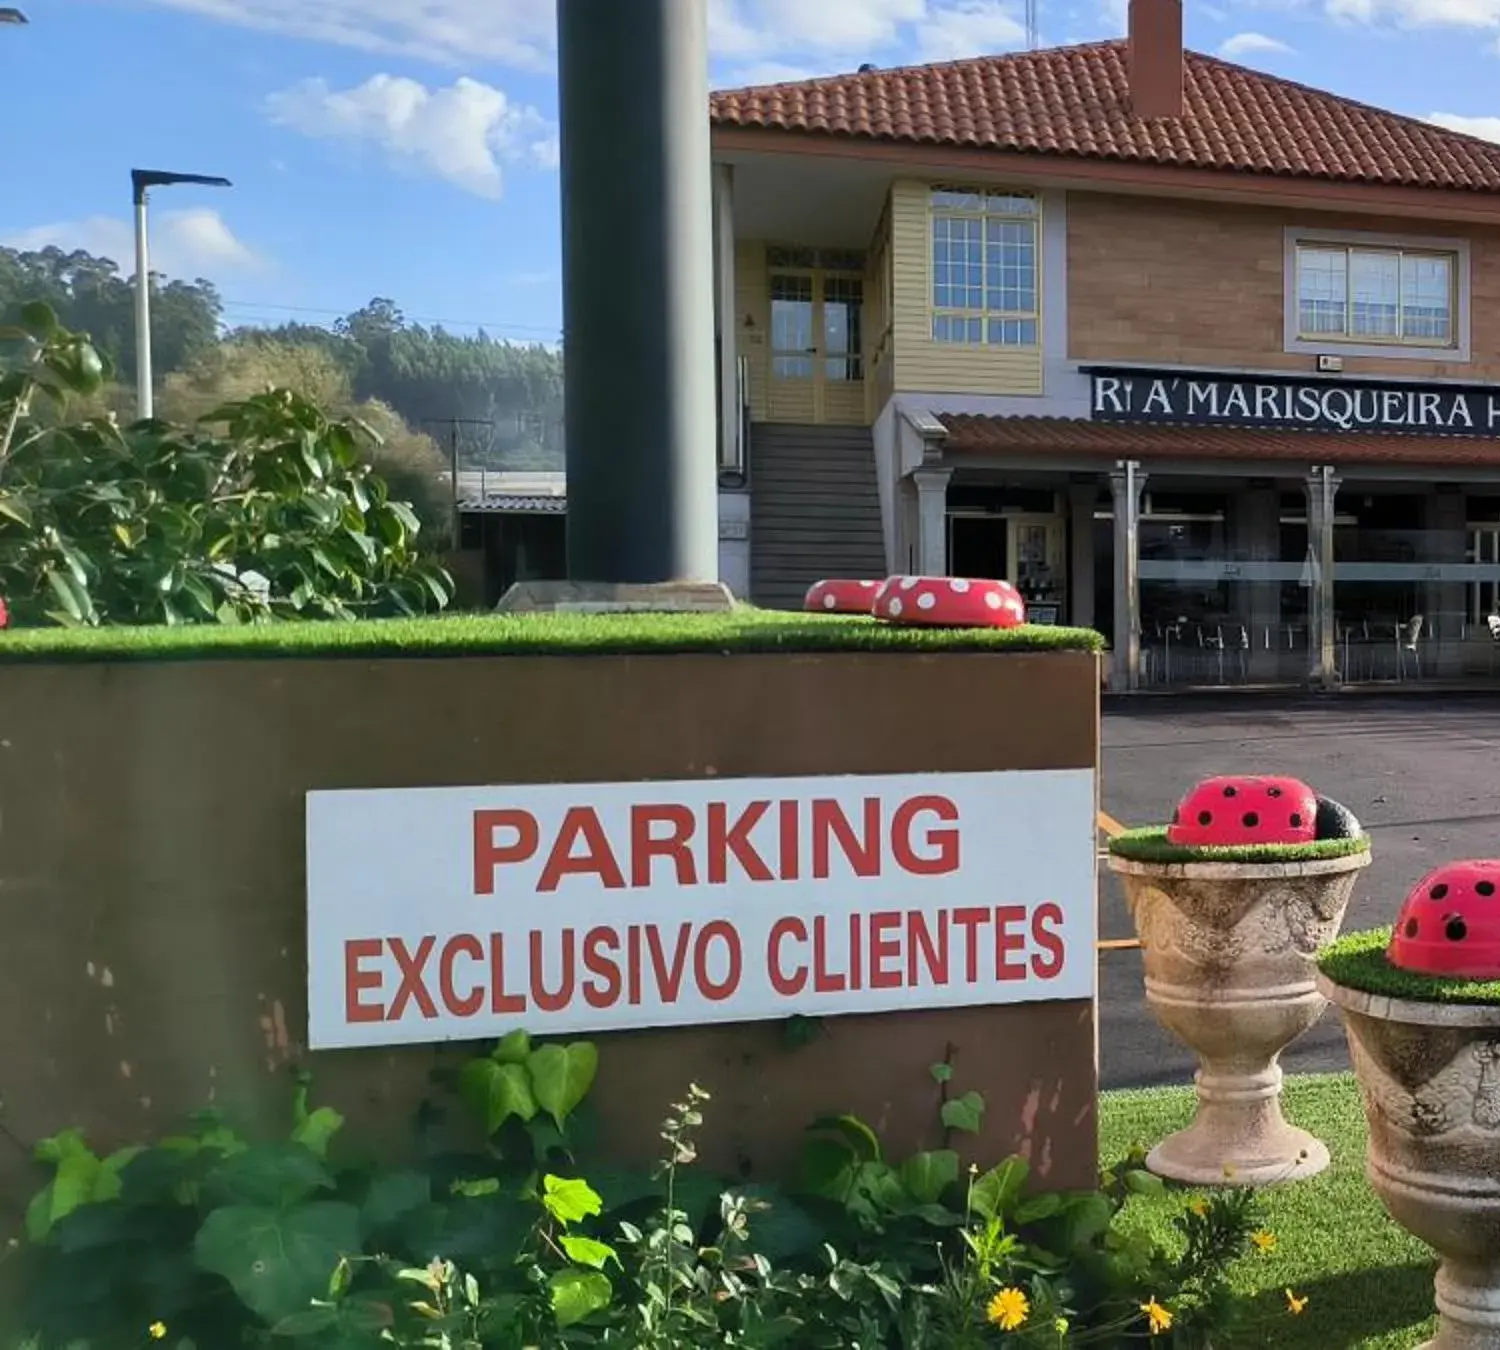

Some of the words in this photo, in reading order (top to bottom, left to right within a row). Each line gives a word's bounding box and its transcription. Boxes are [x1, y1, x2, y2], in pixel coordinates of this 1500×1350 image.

[1095, 376, 1123, 412] R
[472, 795, 960, 896] PARKING
[344, 919, 742, 1024] EXCLUSIVO
[766, 902, 1066, 998] CLIENTES
